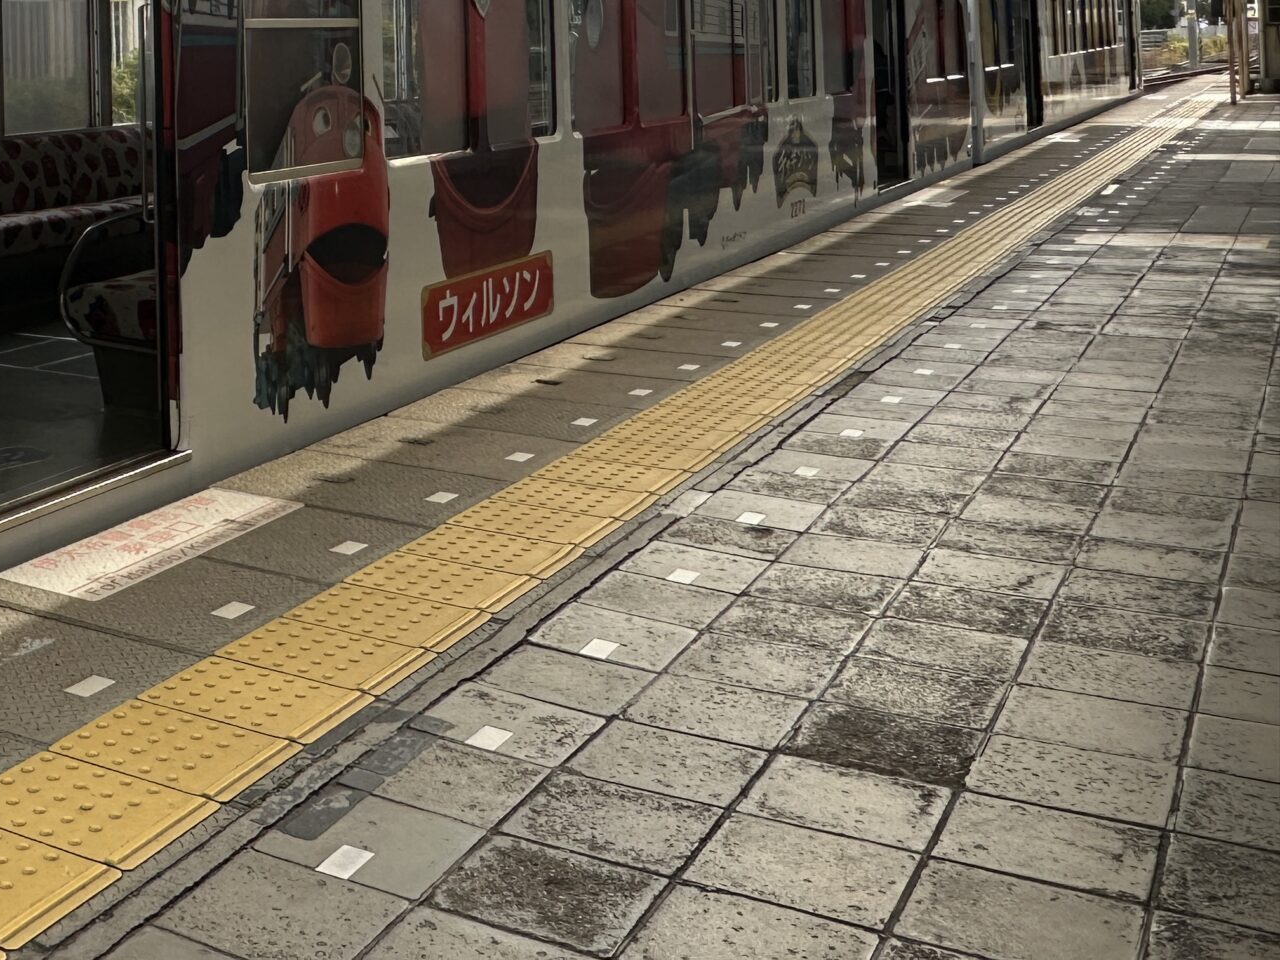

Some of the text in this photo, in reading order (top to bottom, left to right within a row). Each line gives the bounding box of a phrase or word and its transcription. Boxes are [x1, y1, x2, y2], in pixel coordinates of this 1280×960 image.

[438, 269, 540, 342] ウィルソン
[84, 576, 121, 596] For
